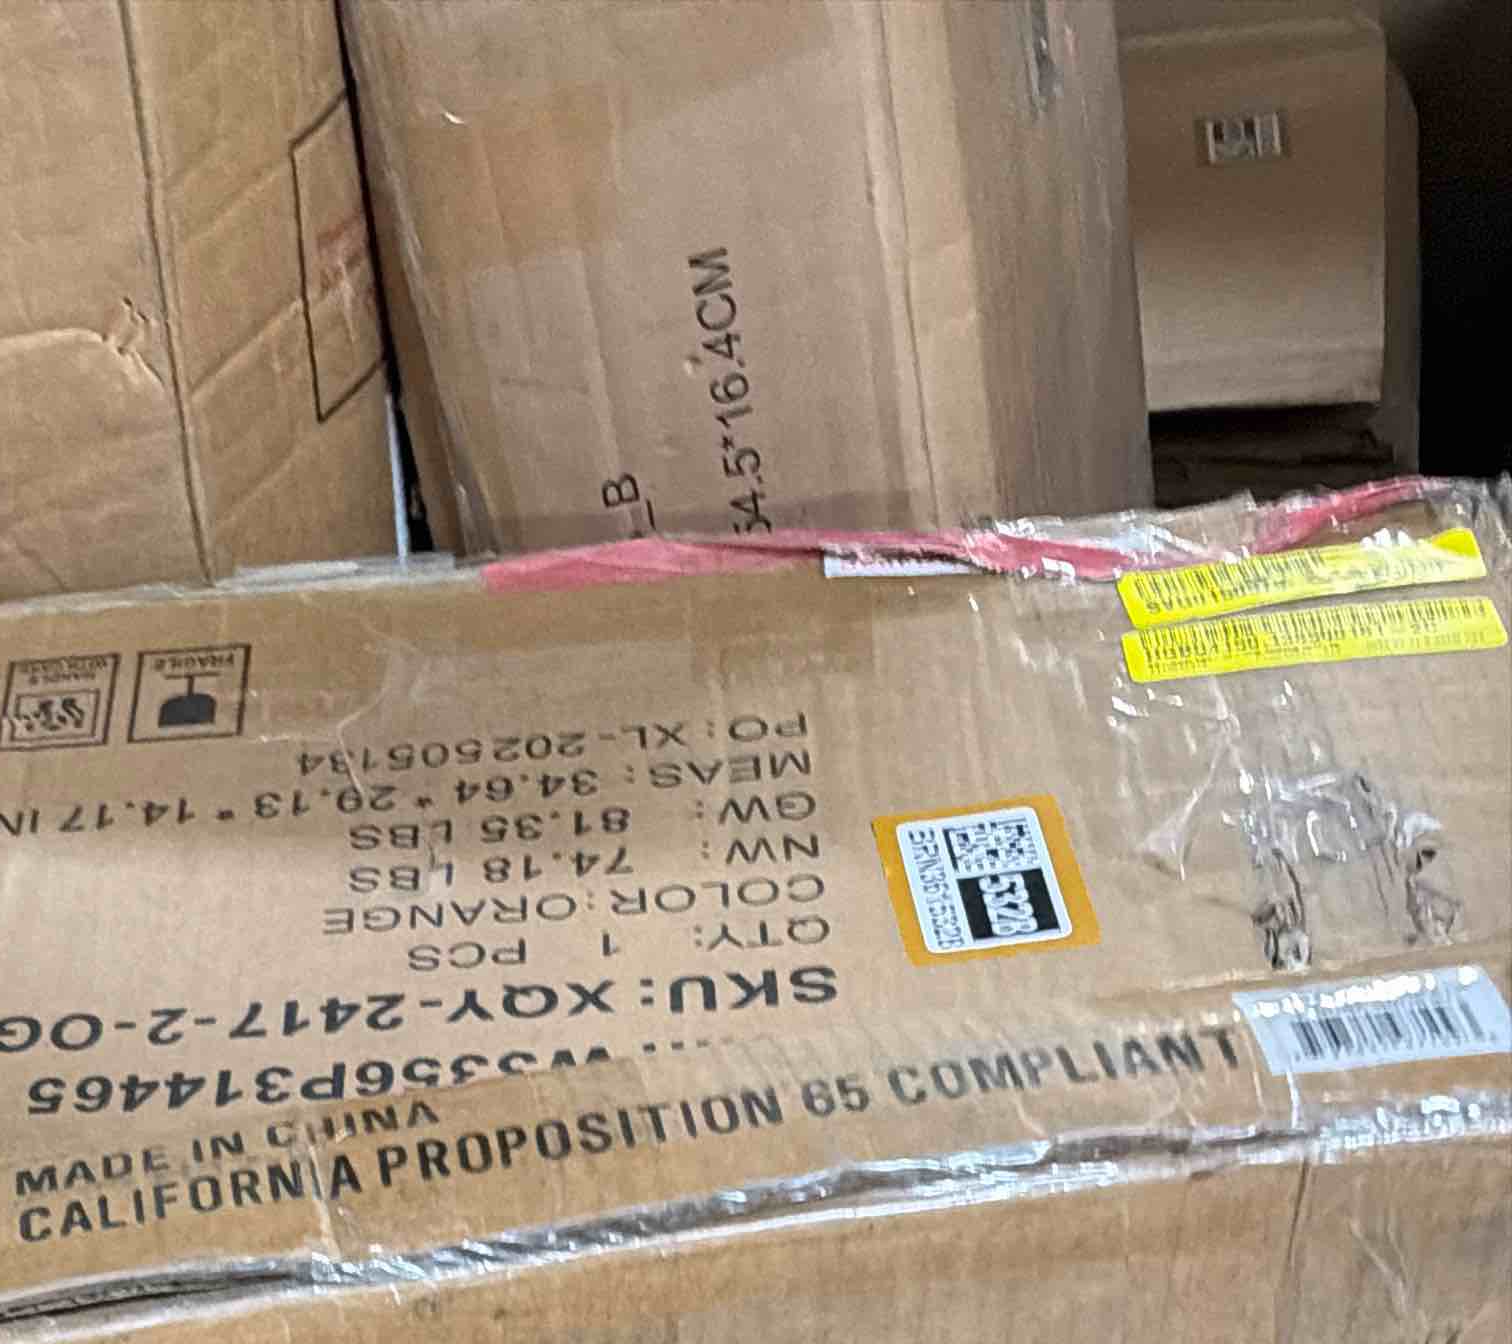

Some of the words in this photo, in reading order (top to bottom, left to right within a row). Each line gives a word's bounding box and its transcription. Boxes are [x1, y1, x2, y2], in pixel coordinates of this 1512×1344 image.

[706, 711, 809, 743] PO:
[455, 768, 600, 803] 34.64
[626, 749, 812, 789] MEAS:
[60, 798, 193, 831] 14.17
[481, 806, 632, 842] 81.35
[696, 789, 817, 824] GW:
[350, 819, 453, 851] LBS
[702, 833, 820, 865] NW:
[350, 862, 455, 894] LBS
[483, 847, 634, 884] 74.18
[600, 932, 621, 958] 1
[694, 914, 830, 952] QTY:
[407, 937, 528, 971] PCS
[639, 966, 839, 1013] SKU:
[14, 1144, 170, 1196] MADE
[192, 1131, 245, 1163] IN
[265, 1100, 440, 1150] CHINA
[18, 1154, 363, 1243] CALIFORNIA
[377, 1087, 784, 1187] PROPOSITION
[801, 1074, 870, 1117] 65
[888, 1026, 1245, 1105] COMPLIANT
